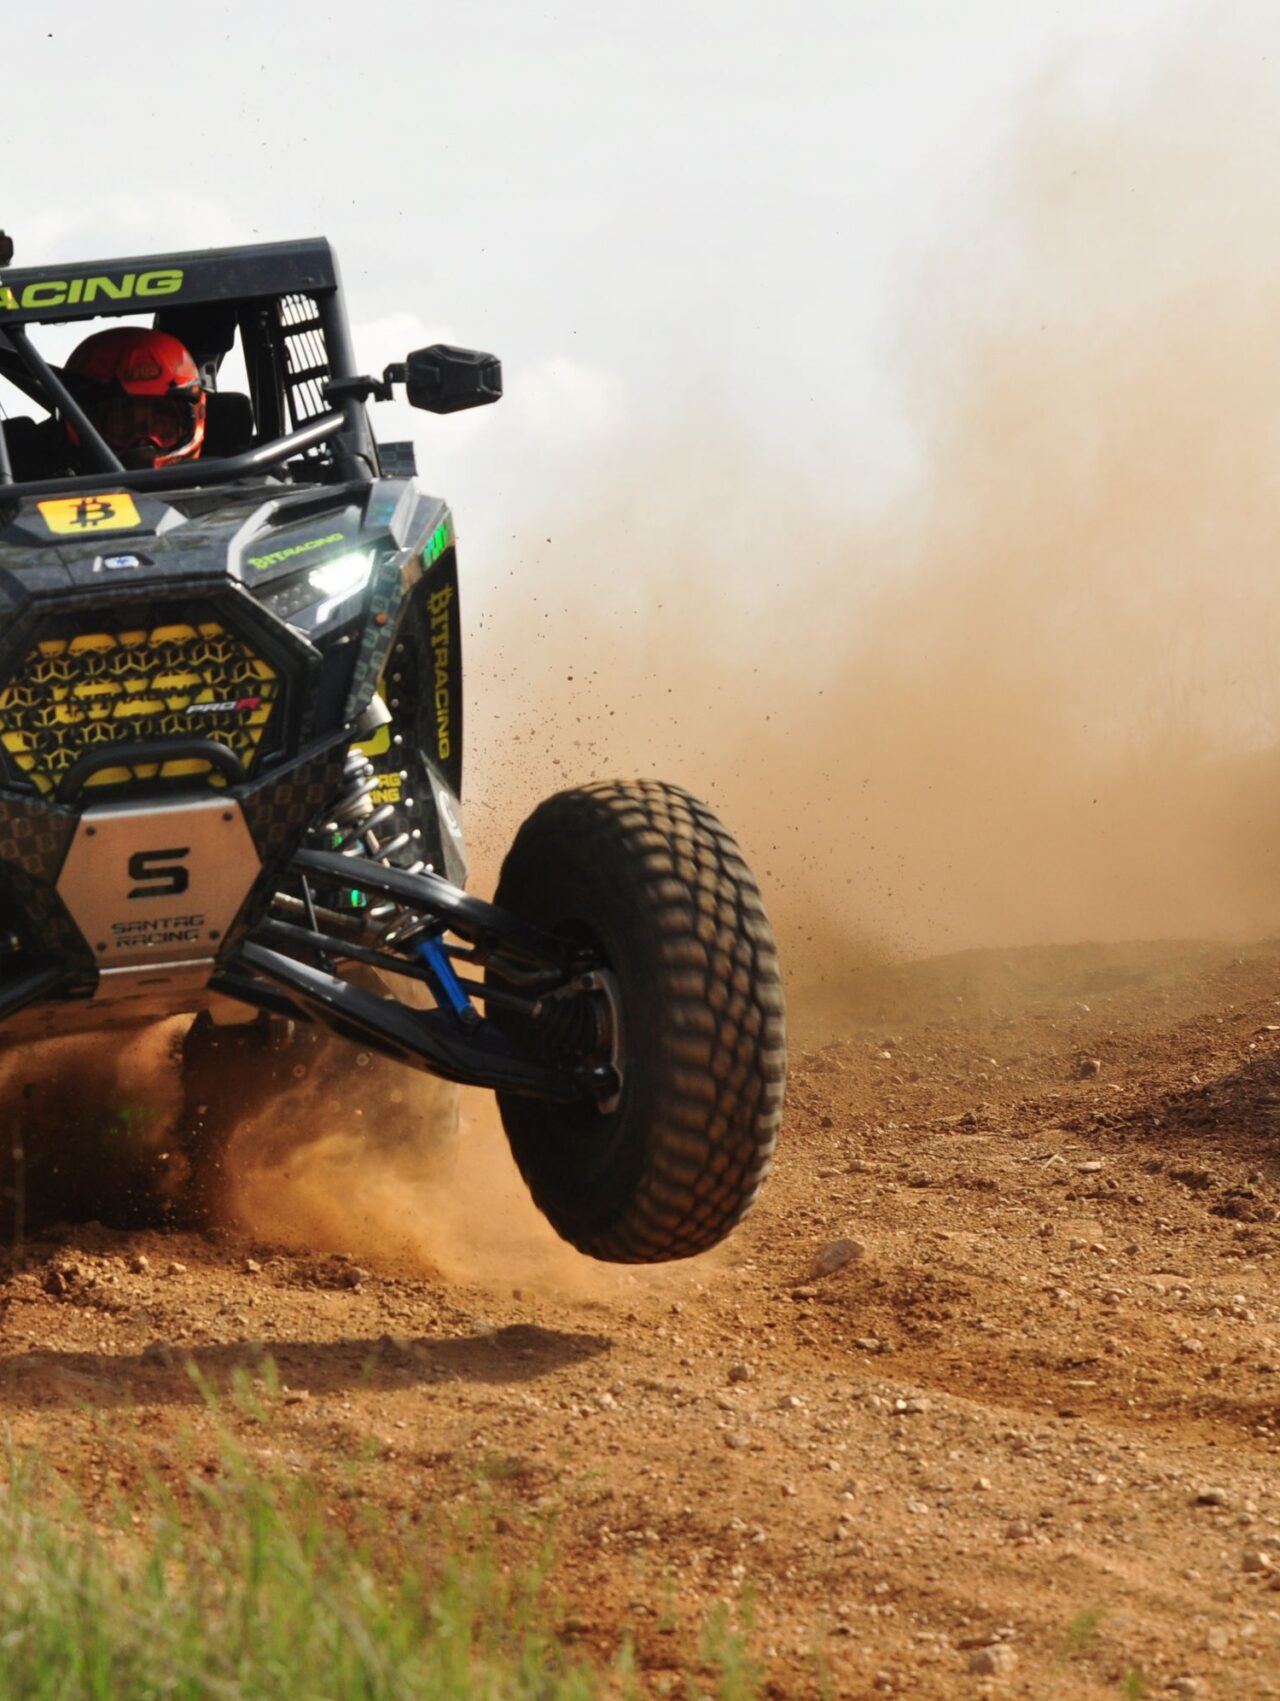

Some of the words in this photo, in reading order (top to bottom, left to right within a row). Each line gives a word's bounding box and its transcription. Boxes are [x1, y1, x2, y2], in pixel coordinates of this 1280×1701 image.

[127, 847, 191, 899] S
[111, 914, 205, 935] SANTAG
[116, 929, 200, 948] RACING
